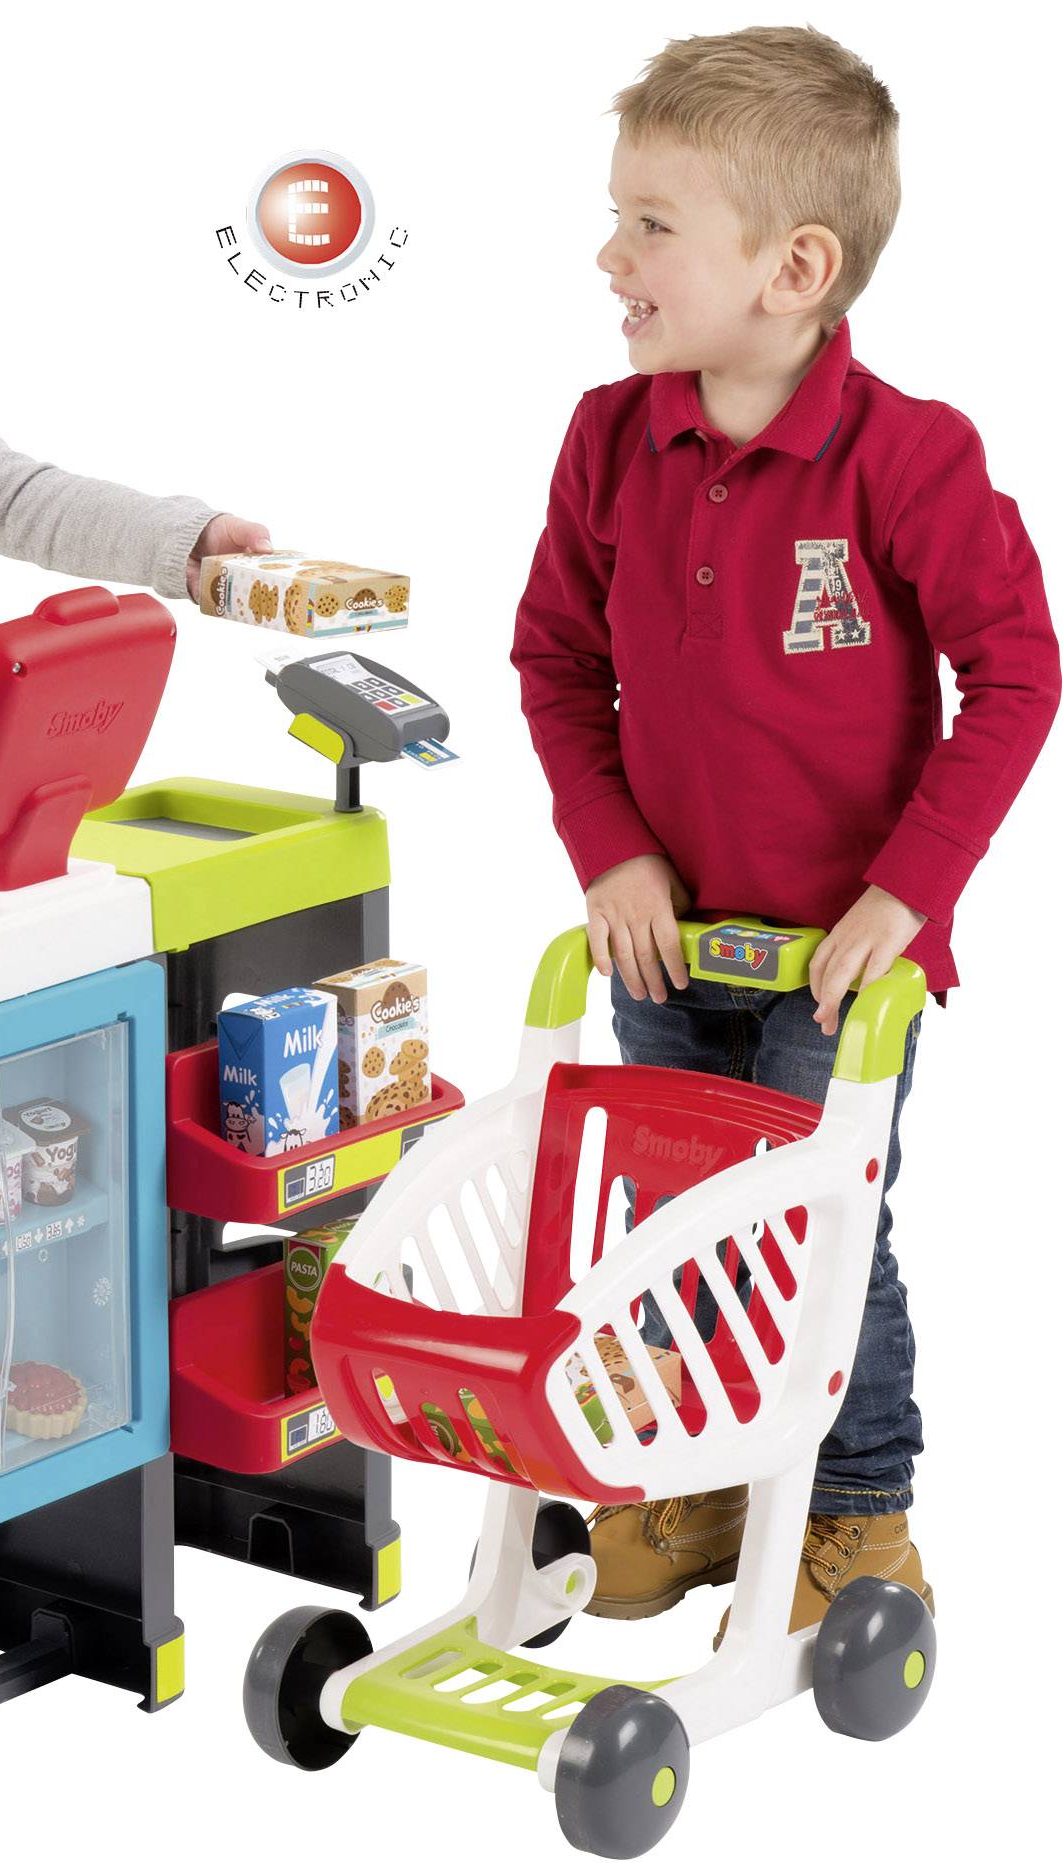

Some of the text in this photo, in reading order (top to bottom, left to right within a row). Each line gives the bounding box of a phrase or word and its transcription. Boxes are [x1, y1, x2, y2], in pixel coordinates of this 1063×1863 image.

[345, 596, 385, 612] Cookie's
[783, 539, 872, 655] A
[46, 698, 125, 739] Smoby
[709, 937, 769, 970] Smoby
[370, 993, 421, 1024] Cookie's
[284, 1024, 324, 1058] Milk
[223, 1064, 258, 1087] Milk
[631, 1124, 725, 1173] Smoby
[290, 1261, 318, 1277] PASTA
